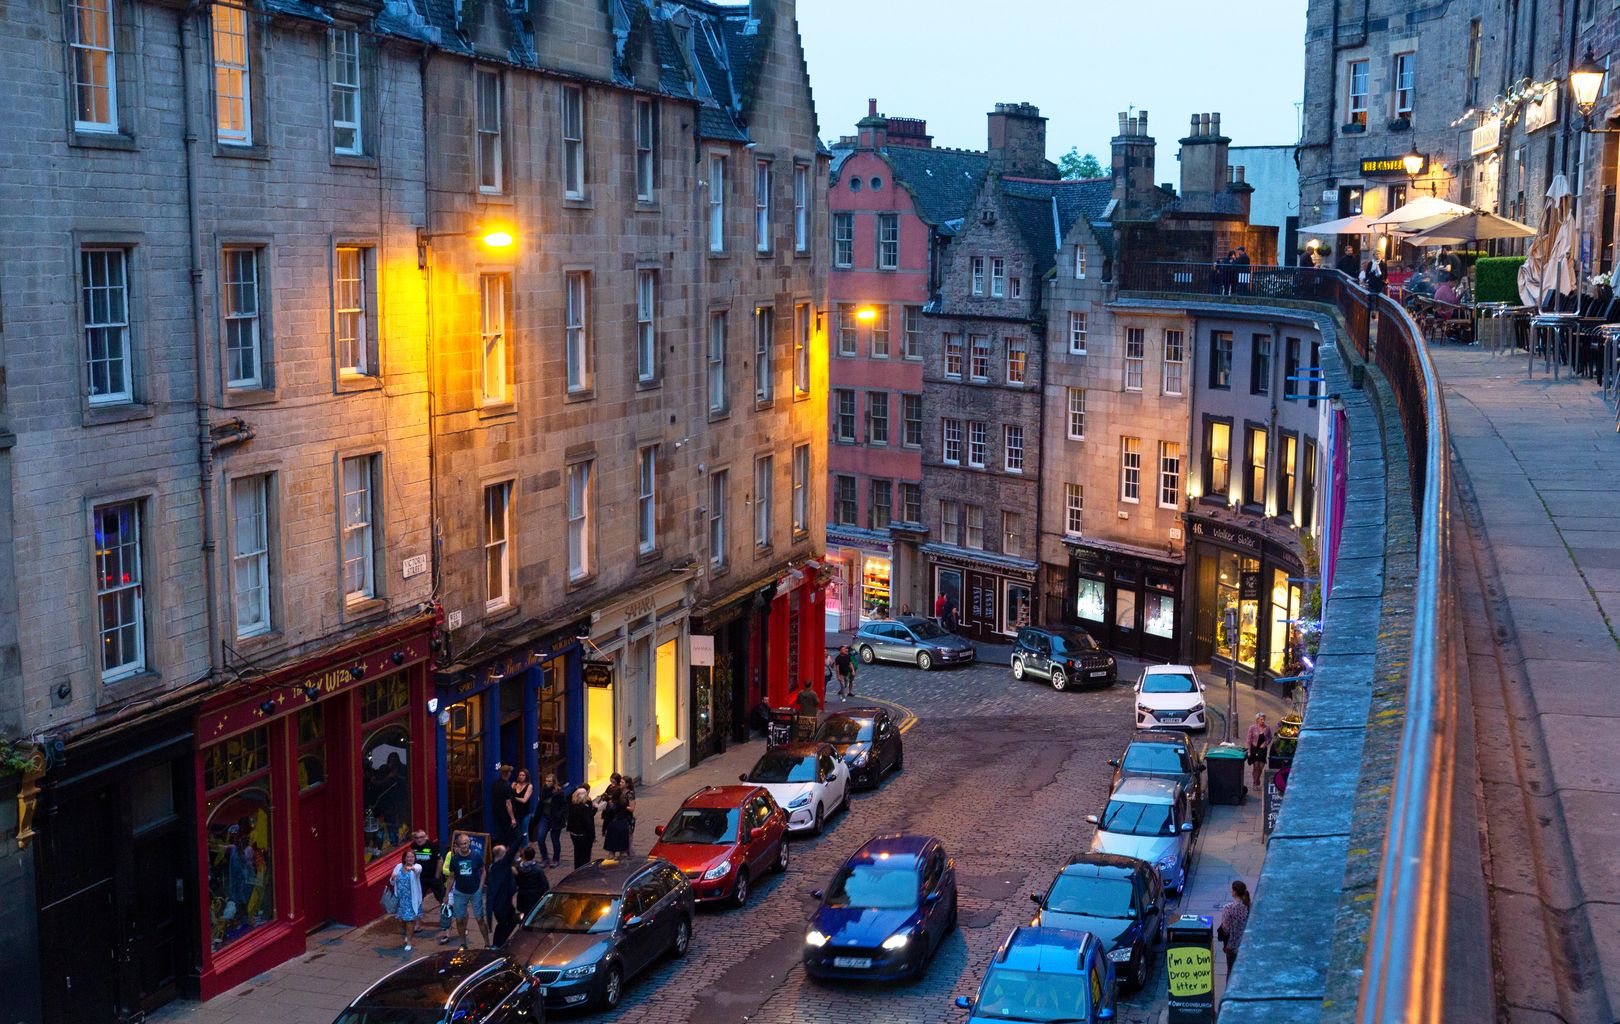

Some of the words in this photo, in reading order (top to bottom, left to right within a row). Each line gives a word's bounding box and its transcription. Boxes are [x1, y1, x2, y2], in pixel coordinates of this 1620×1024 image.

[1377, 160, 1402, 170] CASTLE
[1213, 528, 1235, 541] Walker
[1237, 534, 1256, 548] Slater
[404, 555, 425, 568] VICTORIA
[407, 563, 423, 576] STREET
[624, 595, 657, 622] SAHARA
[325, 662, 359, 692] Wizar
[1168, 954, 1182, 968] I'm
[1197, 954, 1210, 965] bin
[1169, 971, 1190, 980] Drop
[1193, 970, 1210, 979] your
[1177, 982, 1197, 991] litter
